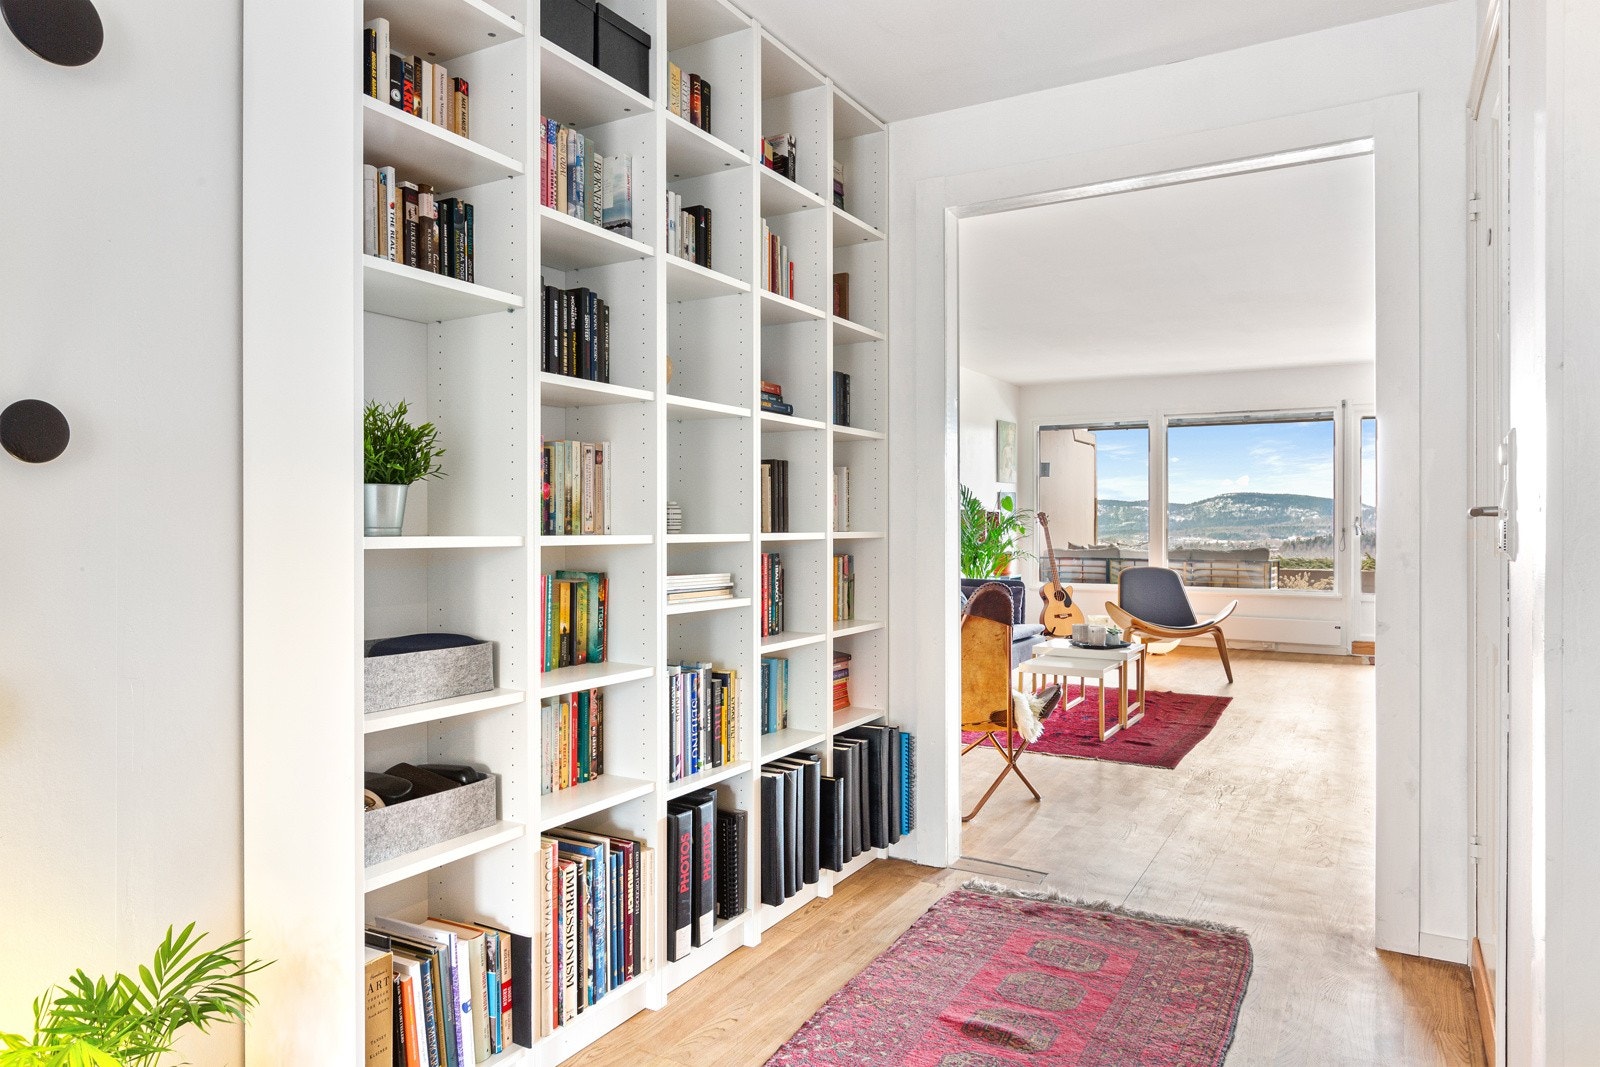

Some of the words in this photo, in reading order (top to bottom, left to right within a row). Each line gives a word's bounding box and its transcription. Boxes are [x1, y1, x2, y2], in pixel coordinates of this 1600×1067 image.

[679, 832, 691, 894] PHOTOS
[702, 822, 712, 881] PHOTOS
[565, 869, 575, 990] IMPRESSIONISM
[366, 975, 390, 996] ART
[425, 989, 434, 1022] KROHG
